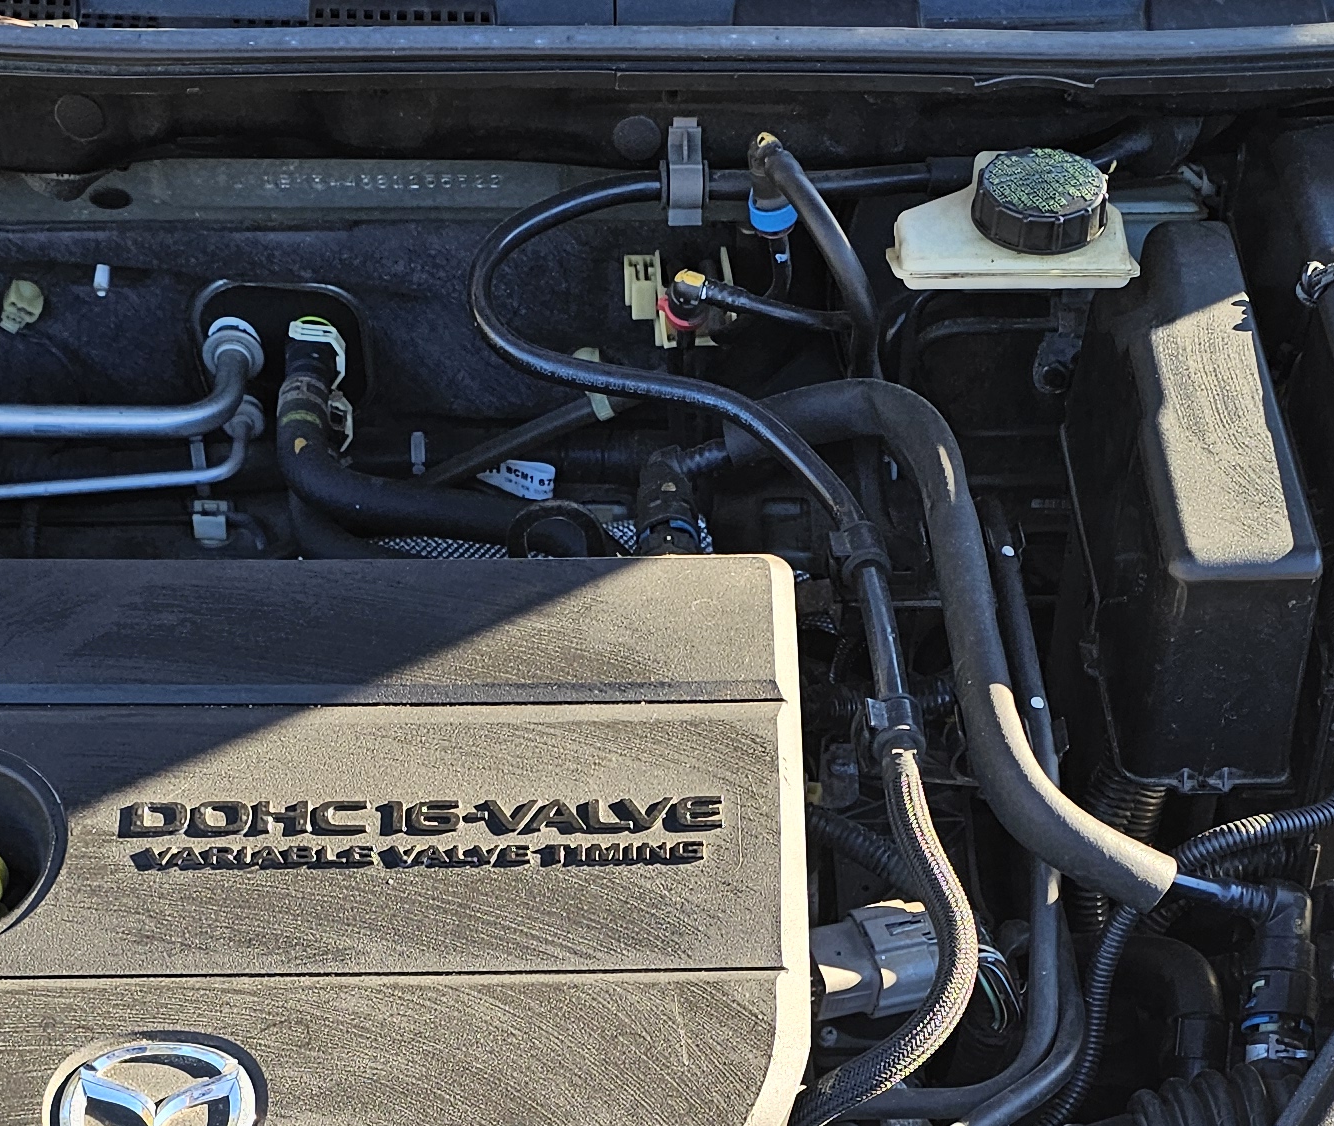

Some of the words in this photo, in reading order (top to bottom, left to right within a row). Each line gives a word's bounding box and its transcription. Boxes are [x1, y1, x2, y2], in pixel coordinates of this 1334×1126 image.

[123, 799, 368, 836] DOHC
[376, 794, 724, 836] 16-VALVE
[133, 845, 375, 870] VARIABLE
[382, 844, 531, 868] VALVE
[537, 839, 705, 867] TIMING
